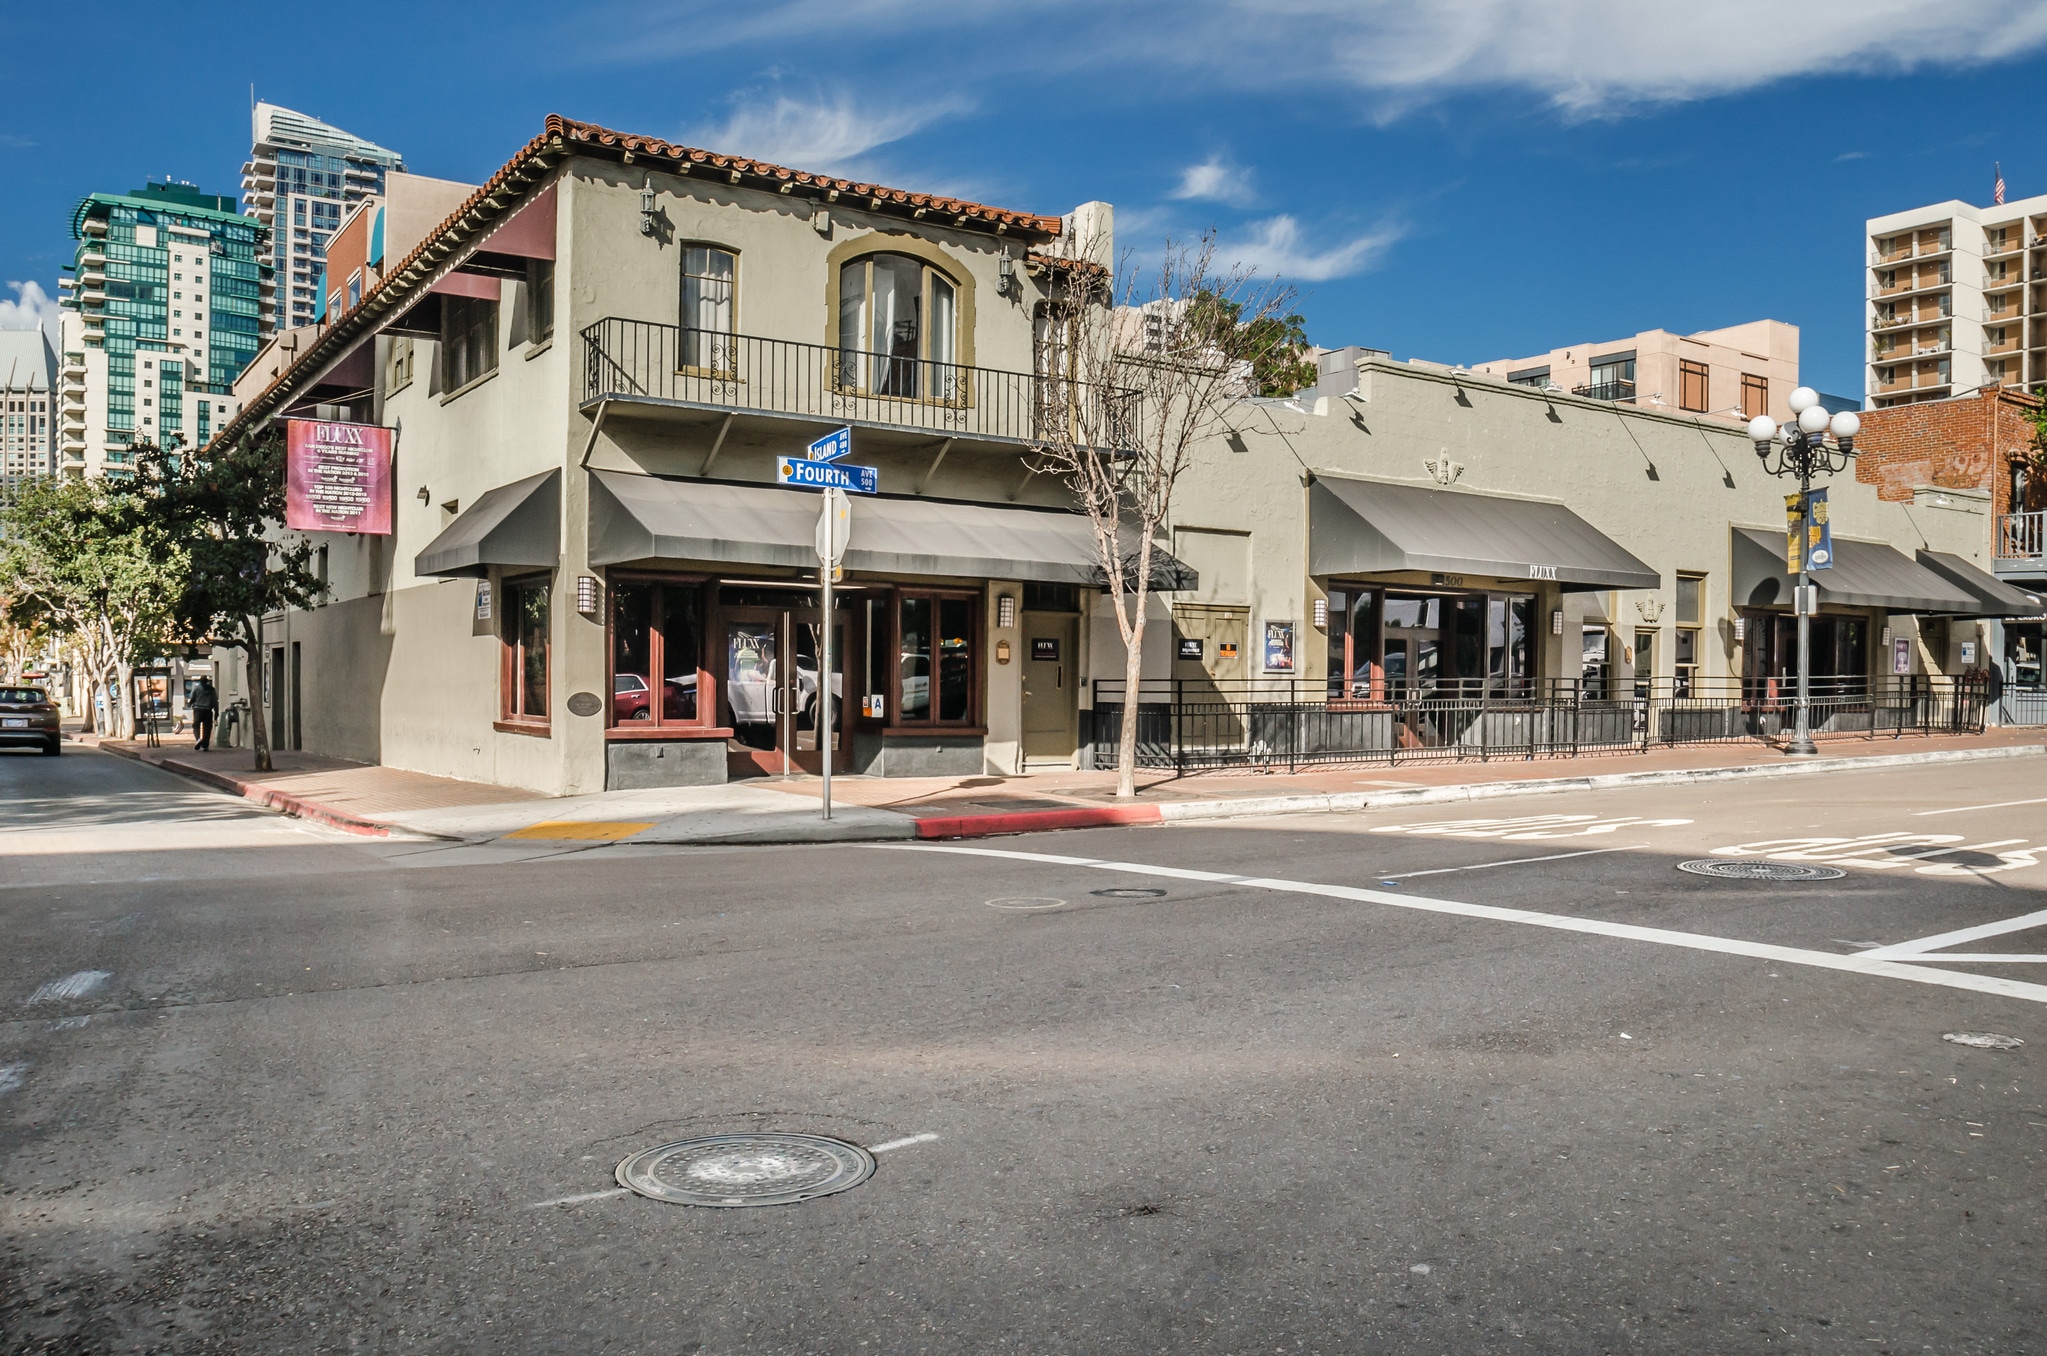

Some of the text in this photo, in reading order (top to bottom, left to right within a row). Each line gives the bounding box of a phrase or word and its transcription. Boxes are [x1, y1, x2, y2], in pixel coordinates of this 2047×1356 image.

[315, 425, 364, 445] FLUXX
[839, 431, 847, 441] AVE
[814, 440, 837, 461] ISLAND
[796, 462, 849, 486] FOURTH
[860, 469, 873, 478] AVE
[860, 479, 873, 487] 500
[1529, 564, 1558, 580] FLUXX
[1445, 576, 1464, 587] 500
[874, 698, 881, 710] A
